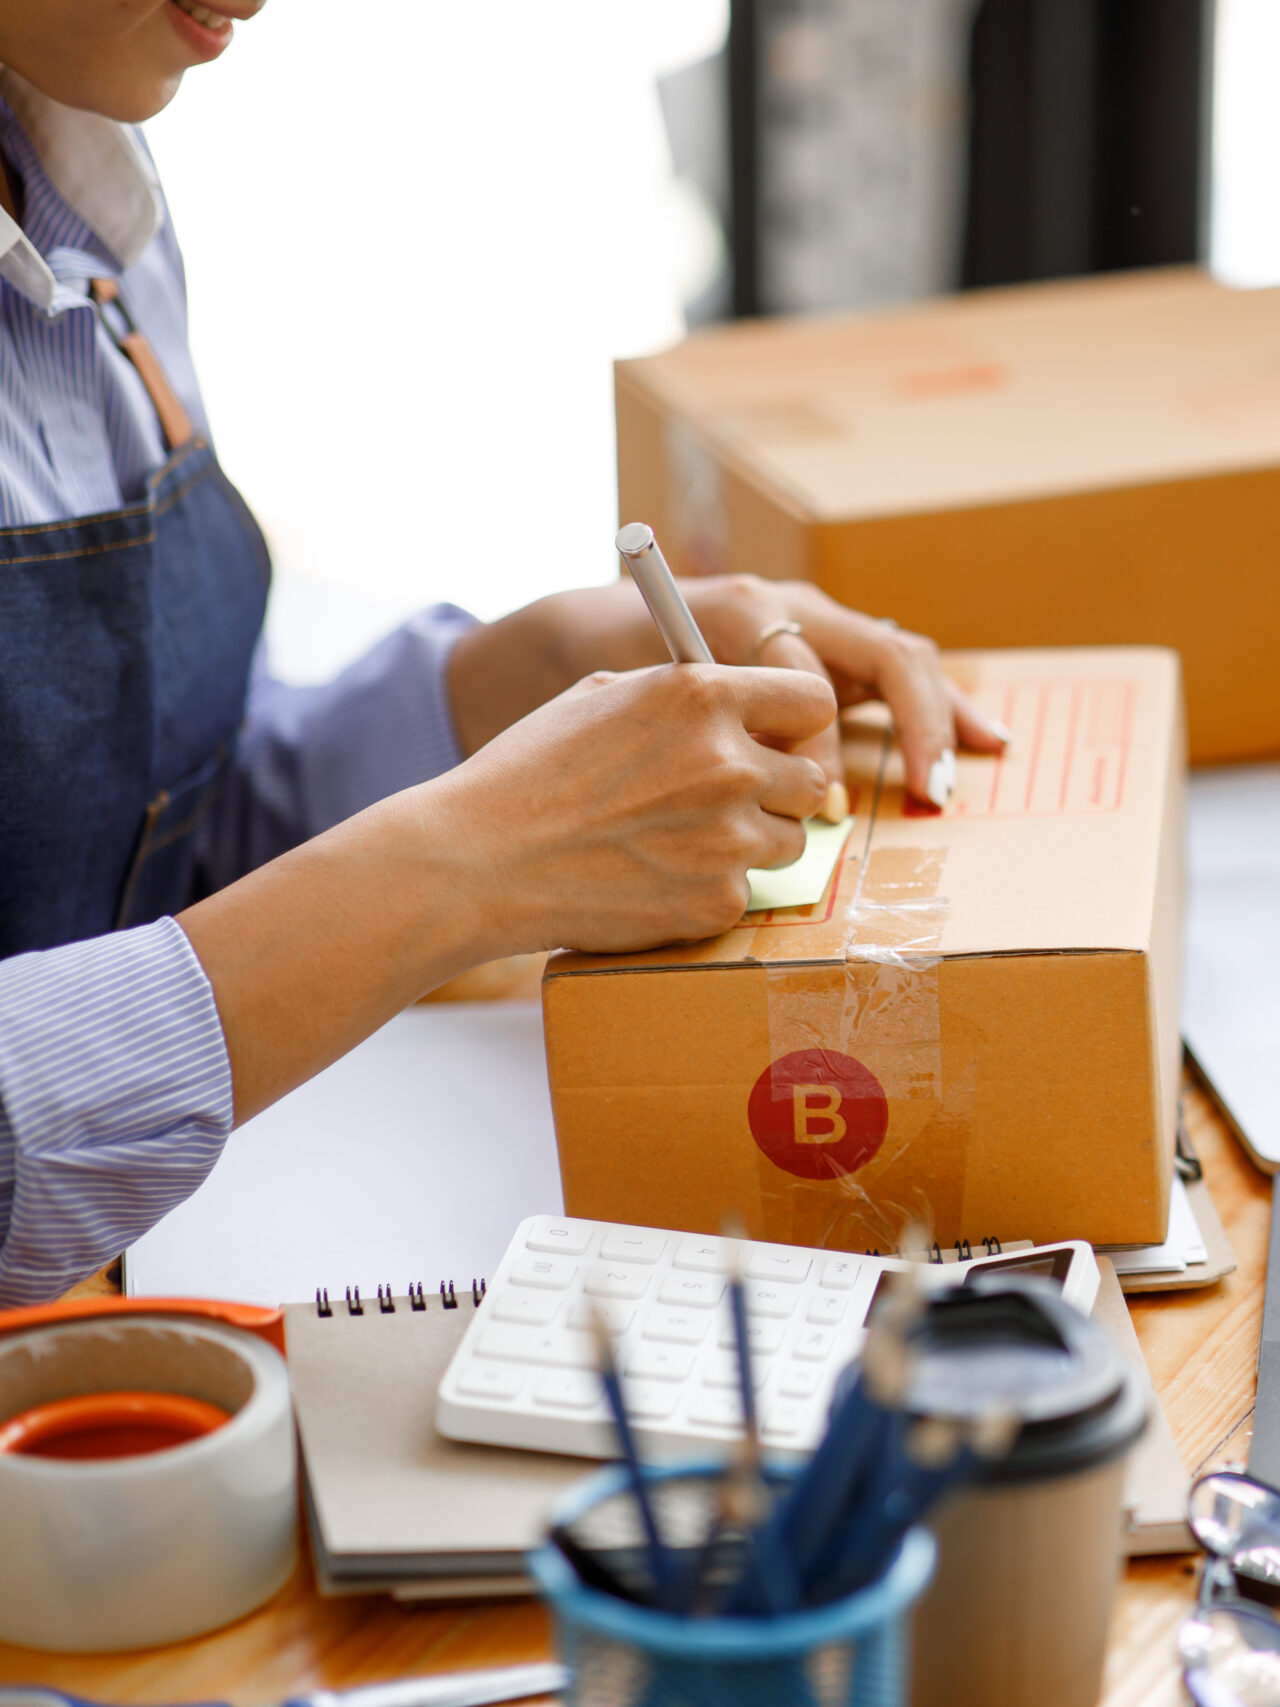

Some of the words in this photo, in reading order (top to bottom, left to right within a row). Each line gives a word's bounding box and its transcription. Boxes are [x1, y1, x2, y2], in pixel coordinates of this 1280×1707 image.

[794, 1084, 847, 1144] B
[607, 1272, 627, 1281] 2
[682, 1281, 702, 1289] 5
